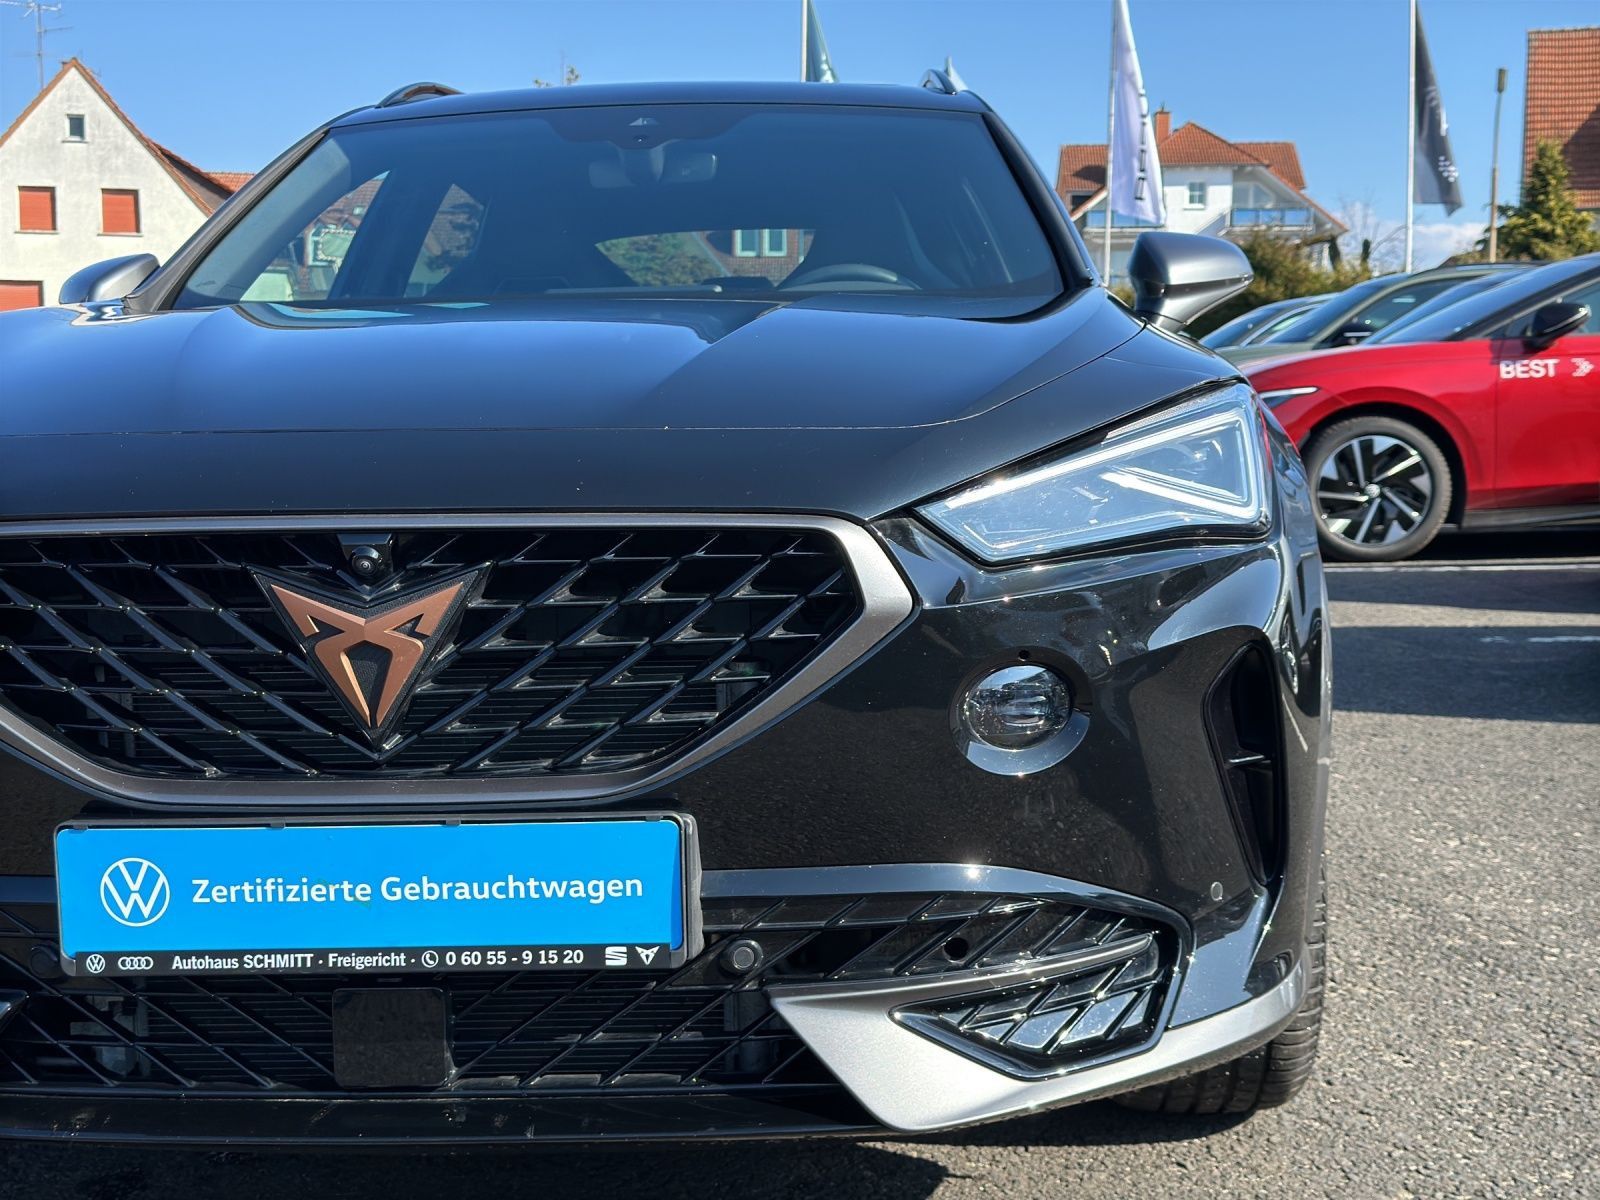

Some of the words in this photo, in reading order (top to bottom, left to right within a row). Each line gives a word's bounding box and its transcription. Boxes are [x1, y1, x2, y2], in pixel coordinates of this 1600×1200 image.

[1500, 359, 1559, 378] BEST
[191, 877, 372, 903] Zertifizierte
[380, 874, 643, 904] Gebrauchtwagen
[172, 955, 239, 970] Autohaus
[243, 953, 314, 968] SCHMITT
[328, 952, 406, 970] Freigericht
[445, 951, 456, 966] 0
[460, 951, 482, 966] 60
[486, 950, 507, 965] 55
[522, 950, 532, 965] 9
[538, 950, 558, 964] 15
[562, 949, 584, 964] 20
